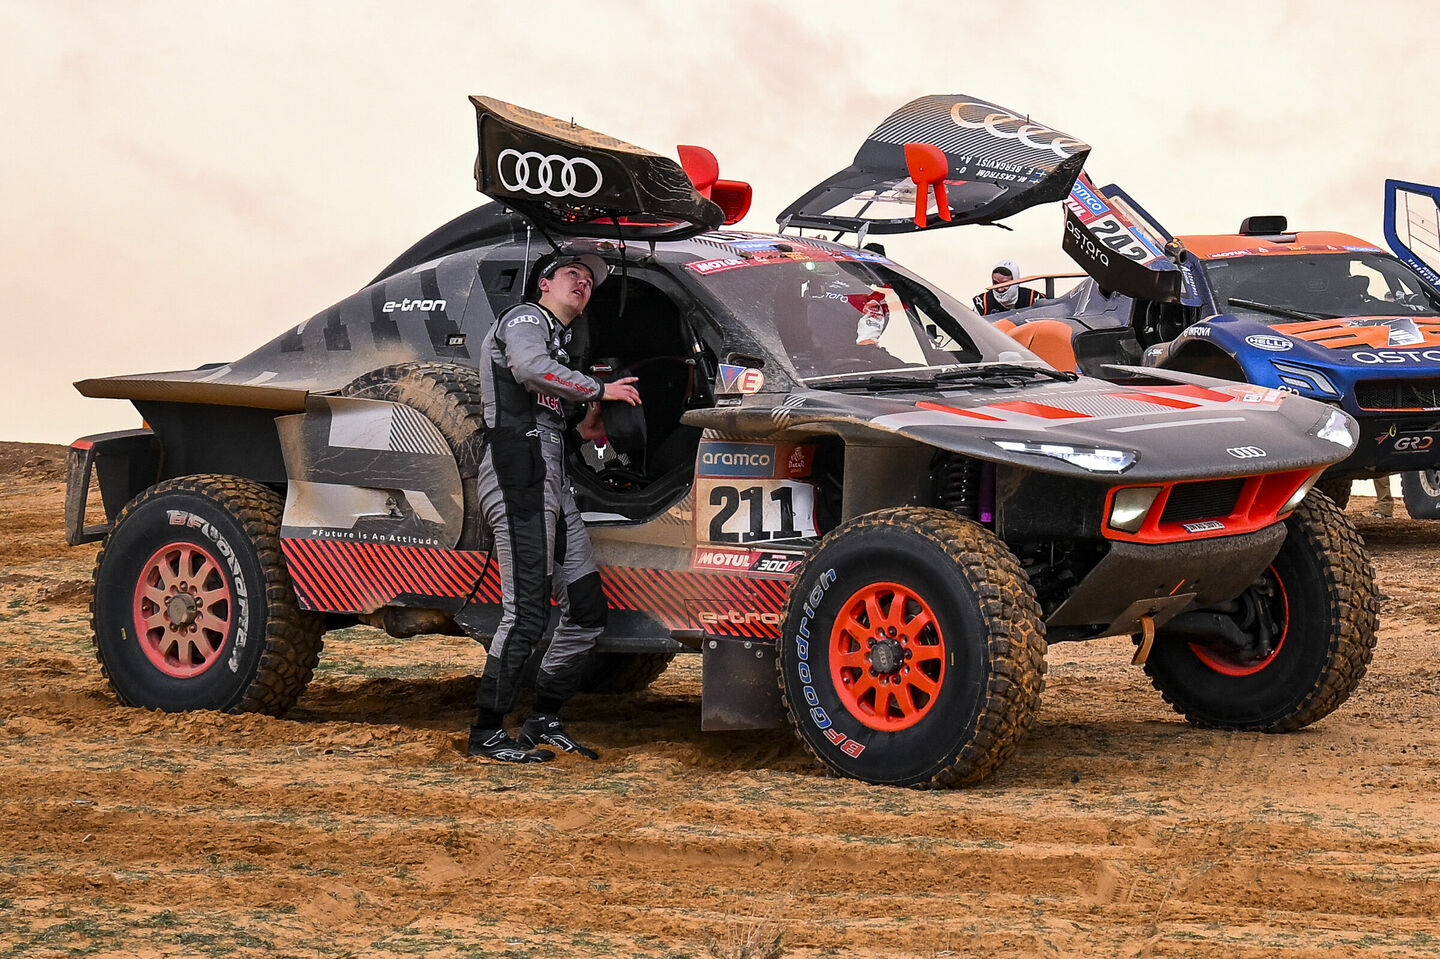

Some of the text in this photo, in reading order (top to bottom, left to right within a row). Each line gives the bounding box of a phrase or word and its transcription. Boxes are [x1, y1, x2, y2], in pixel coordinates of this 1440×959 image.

[975, 159, 1023, 173] BERGKVIST
[1072, 182, 1103, 211] amco
[1066, 220, 1110, 267] astara
[1090, 219, 1149, 261] 242
[382, 297, 447, 313] e-tron
[702, 452, 771, 467] aramco
[709, 485, 803, 544] 211
[312, 529, 354, 539] #Future
[371, 533, 385, 541] An
[389, 534, 439, 546] Attitude
[697, 551, 752, 567] MOTUL
[757, 559, 802, 573] 300V
[698, 610, 784, 625] e-tro
[796, 568, 866, 759] BFGoodrich
